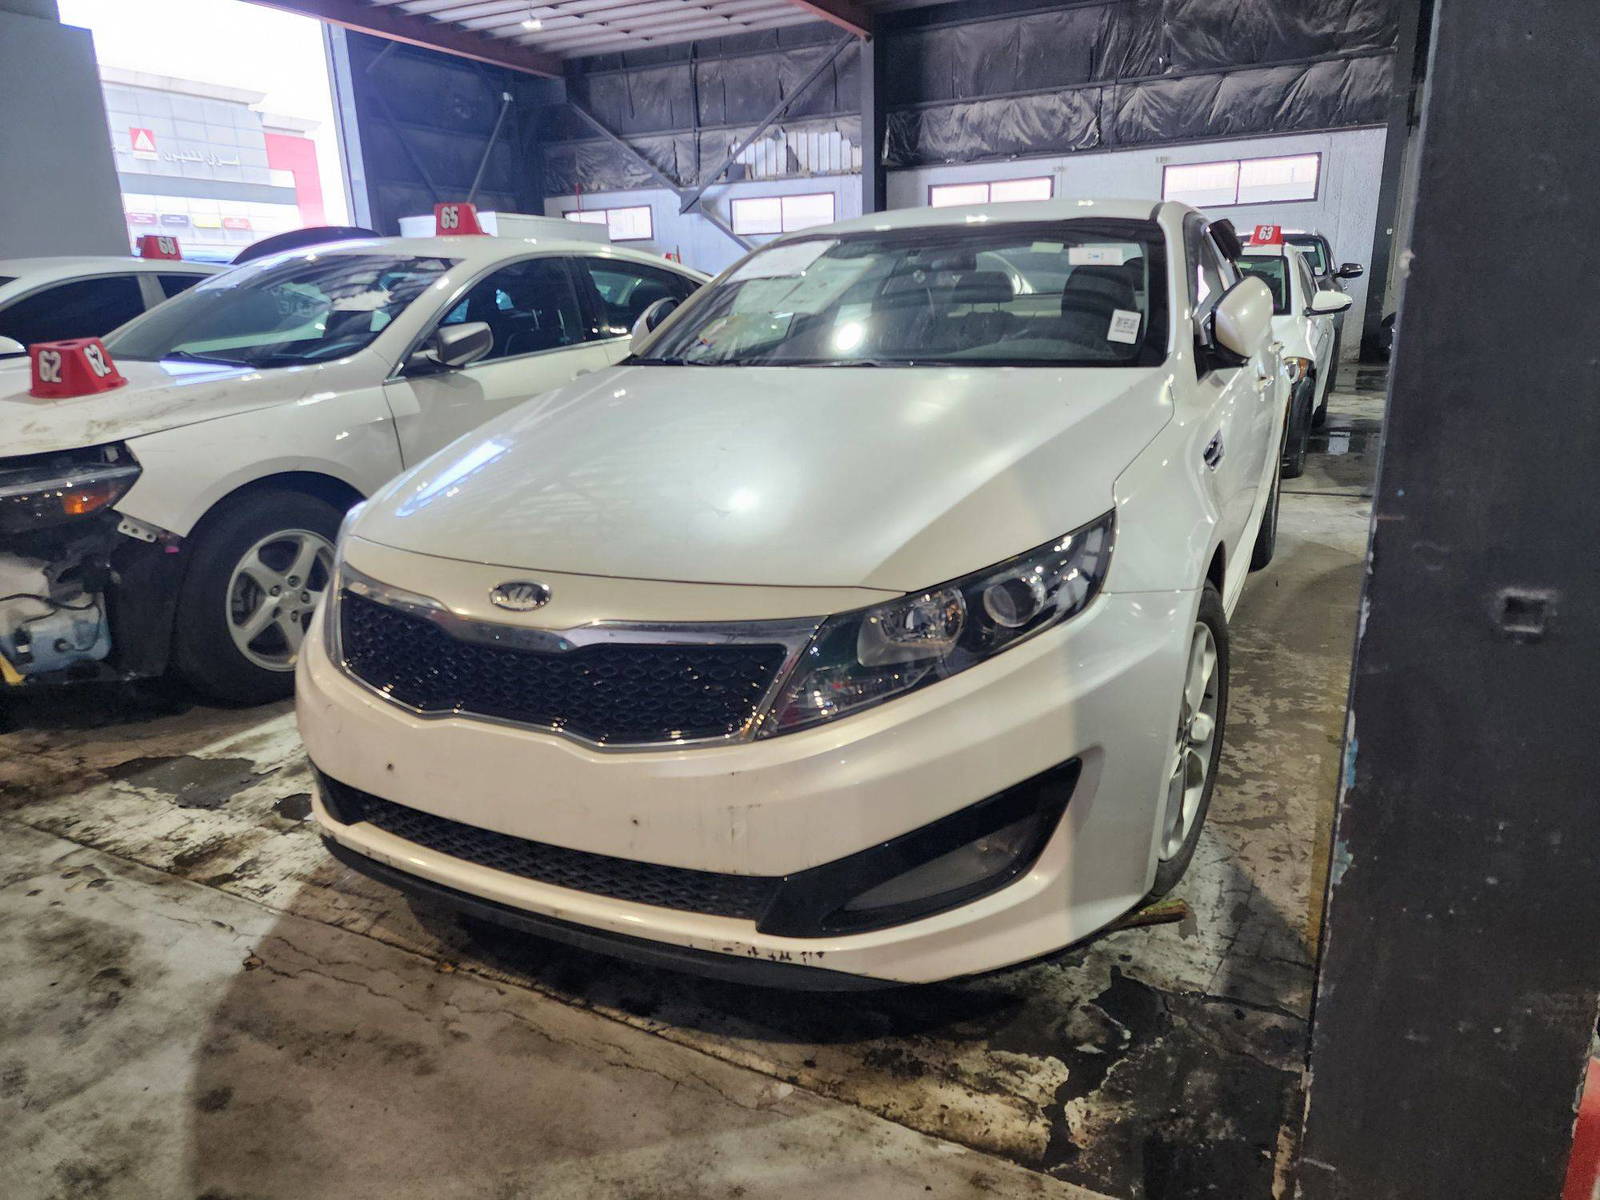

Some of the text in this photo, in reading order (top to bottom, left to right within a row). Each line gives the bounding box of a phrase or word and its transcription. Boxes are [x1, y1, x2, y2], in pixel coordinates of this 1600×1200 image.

[441, 206, 458, 229] 65
[1259, 226, 1273, 240] 63
[39, 350, 62, 382] 62
[84, 344, 111, 377] 62
